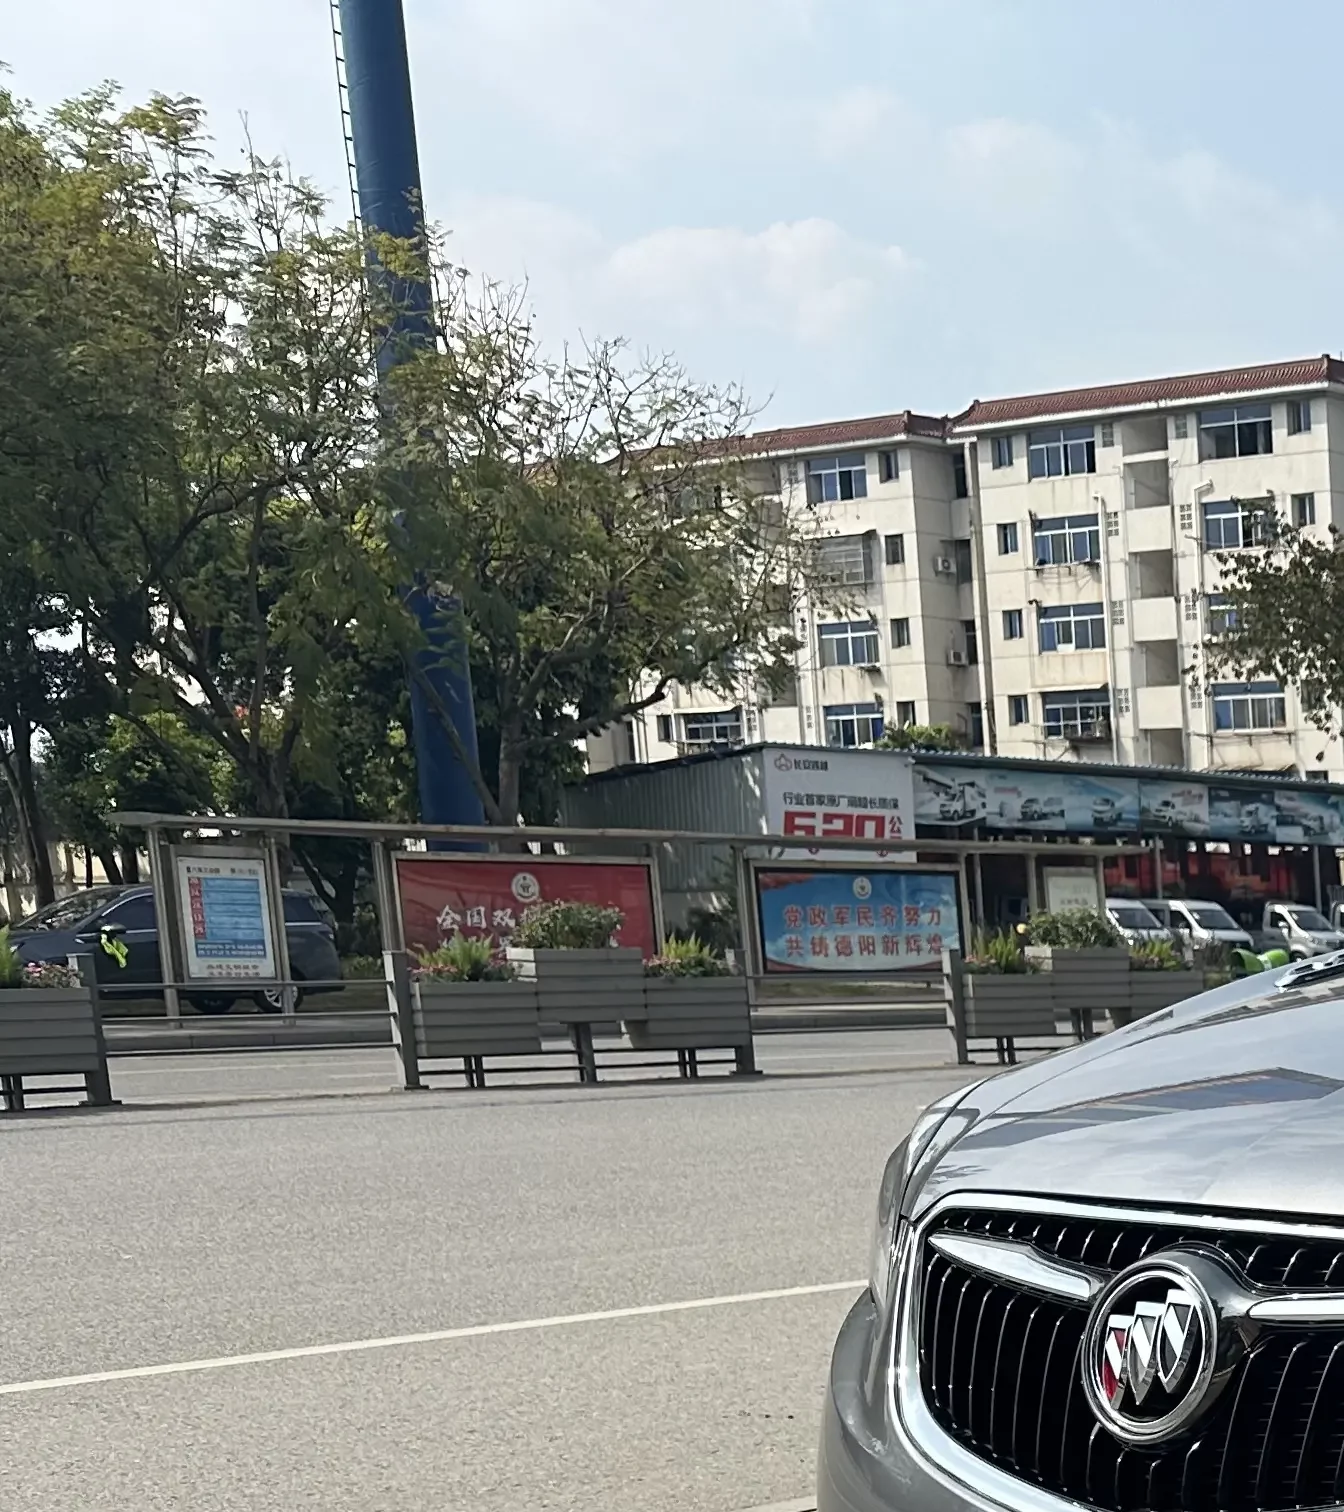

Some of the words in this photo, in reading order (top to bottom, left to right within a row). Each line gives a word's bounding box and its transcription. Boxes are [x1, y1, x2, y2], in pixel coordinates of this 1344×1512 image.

[784, 904, 941, 928] 党政军民齐努力
[785, 932, 943, 958] 共铸德阳新辉煌
